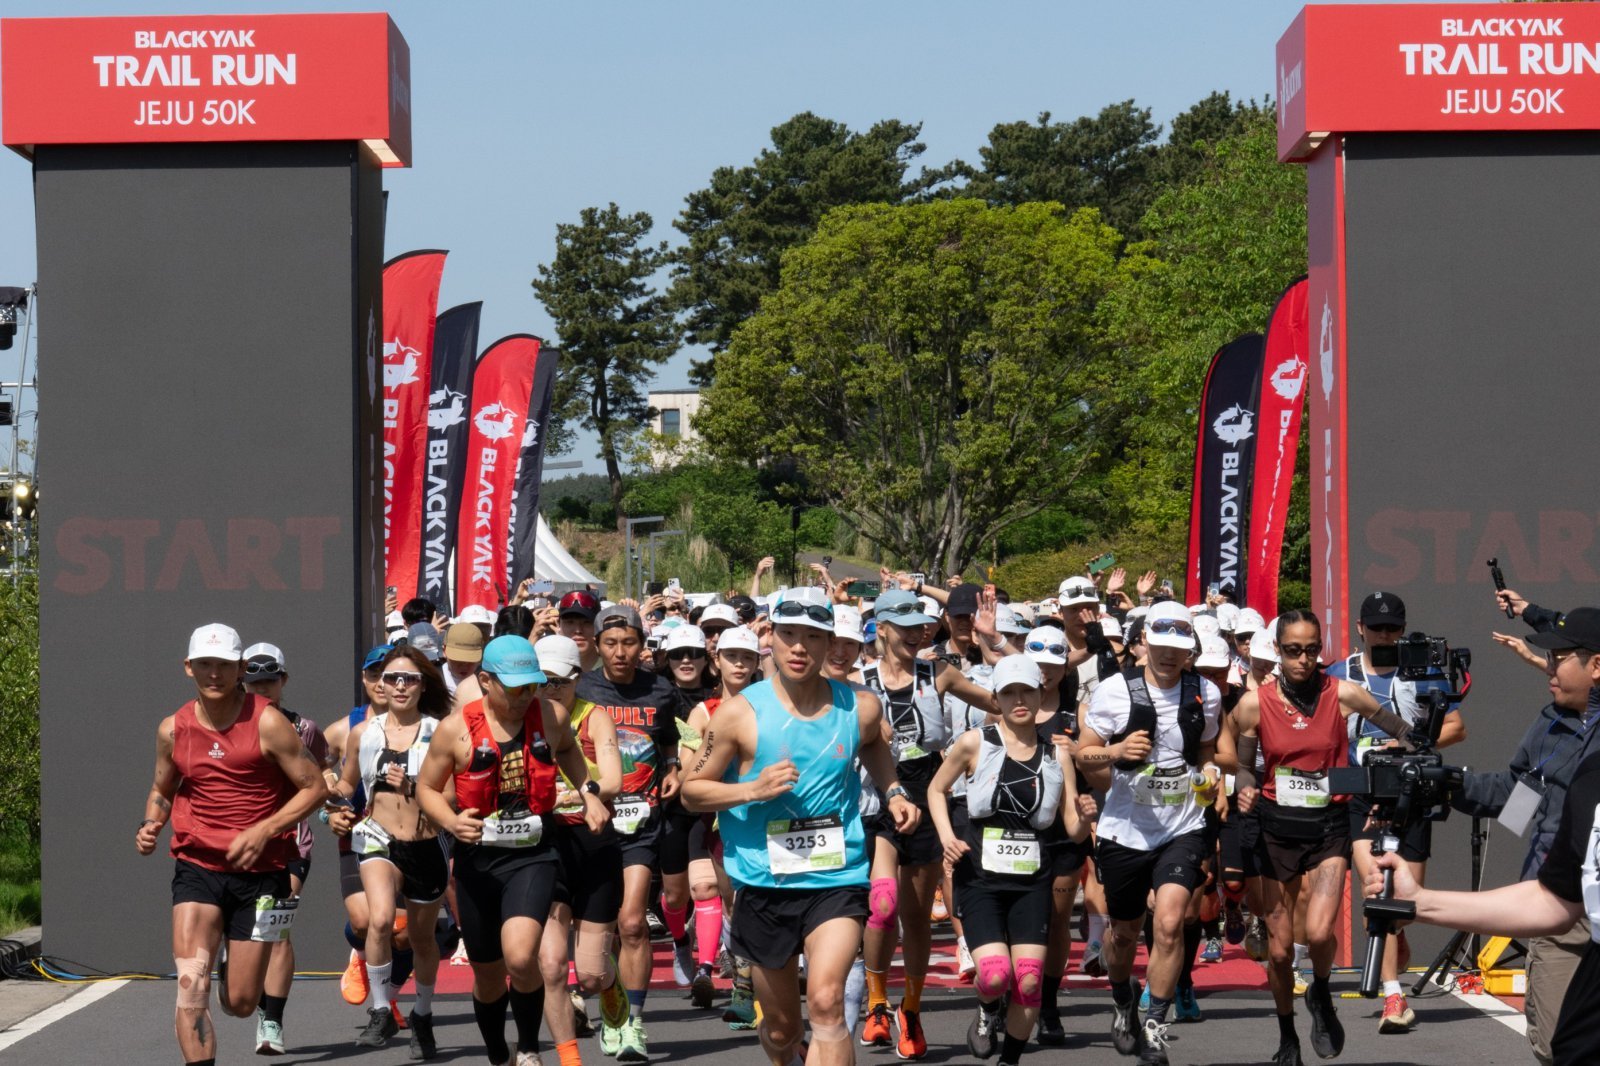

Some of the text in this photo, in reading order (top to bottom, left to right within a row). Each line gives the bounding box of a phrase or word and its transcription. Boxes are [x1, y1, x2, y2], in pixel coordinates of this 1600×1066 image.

[93, 54, 297, 87] TRAIL RUN
[1399, 42, 1600, 75] TRAIL RUN
[134, 99, 256, 126] JEJU 50K
[1441, 88, 1564, 114] JEJU 50K
[54, 514, 342, 595] START
[1363, 508, 1600, 587] STAR
[1147, 780, 1179, 790] 3252
[1289, 780, 1320, 791] 3283
[496, 823, 531, 834] 3222
[785, 834, 827, 851] 3253
[996, 844, 1030, 856] 3267
